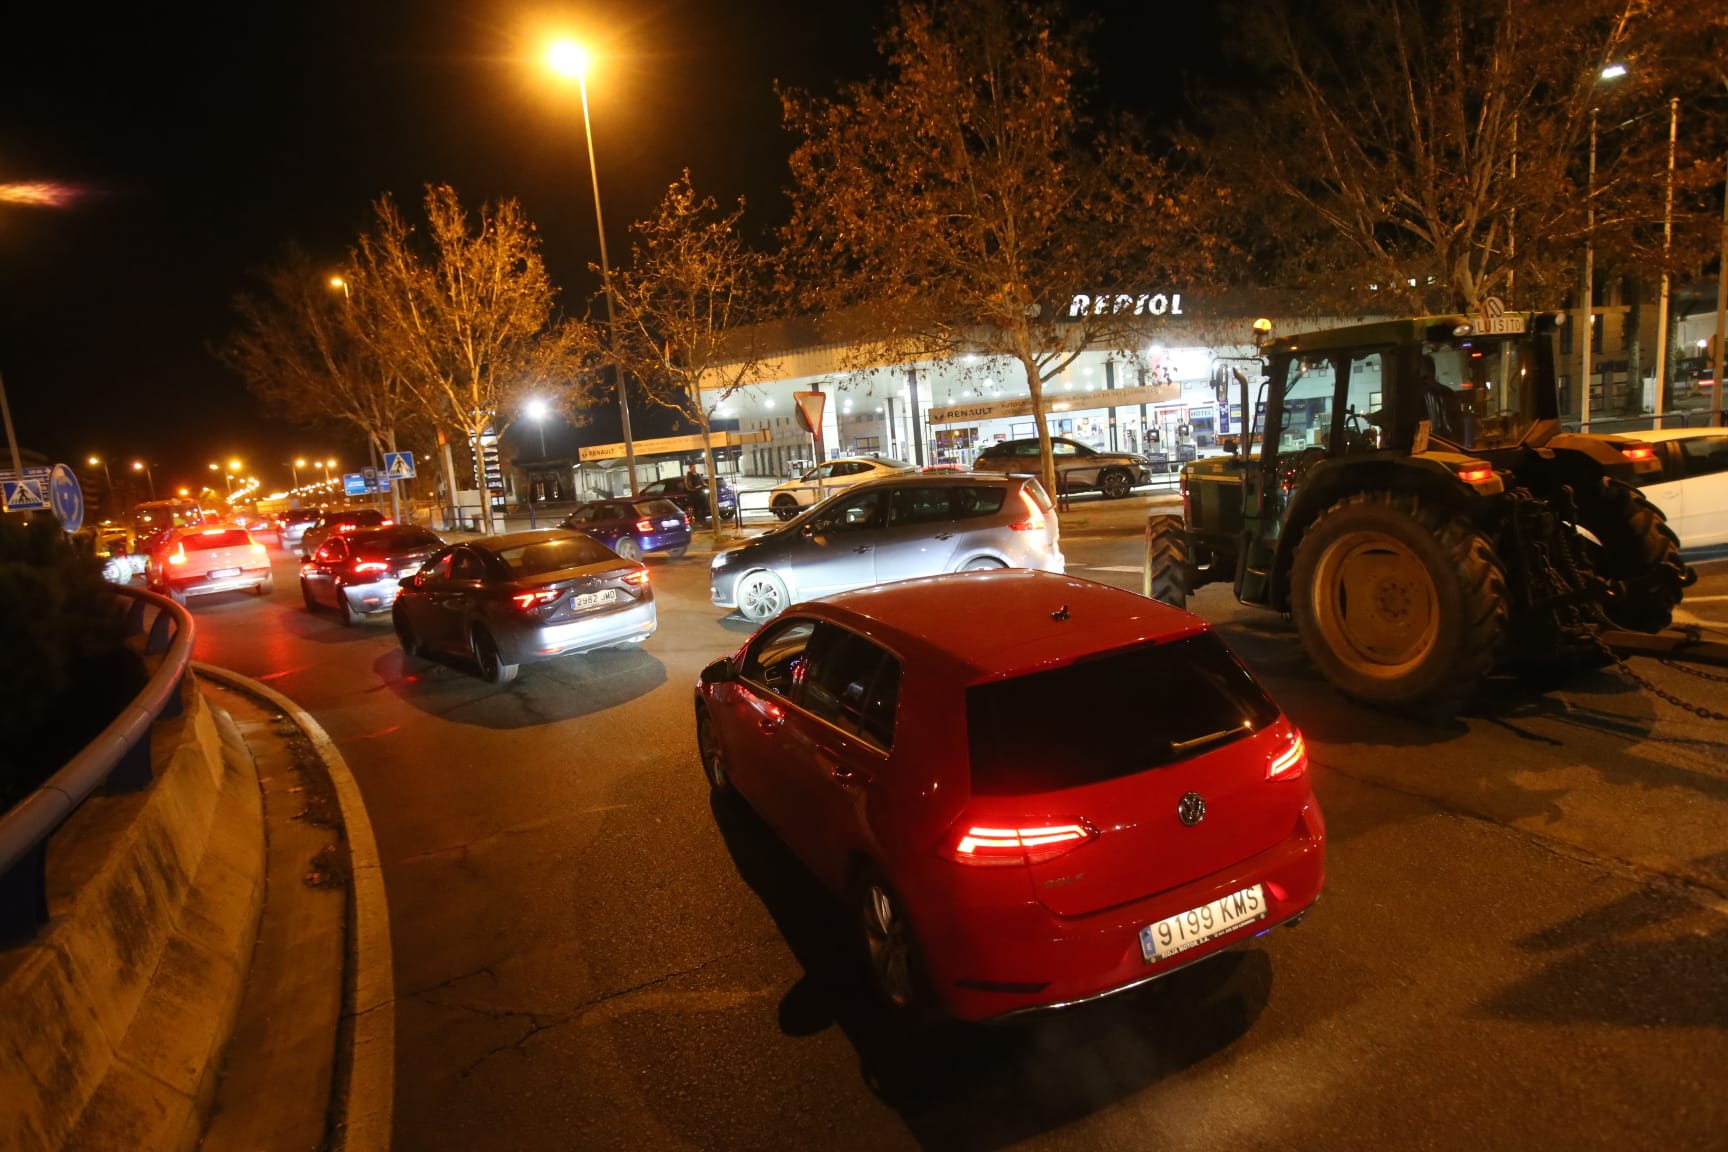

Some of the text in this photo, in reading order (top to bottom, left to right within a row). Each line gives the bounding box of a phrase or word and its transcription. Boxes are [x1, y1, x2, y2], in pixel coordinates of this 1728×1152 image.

[1069, 293, 1183, 317] REPSOL
[1477, 319, 1521, 333] LUISITO
[947, 407, 993, 419] RENAULT
[588, 448, 615, 457] RENAULT
[1158, 905, 1214, 946] 9199
[1219, 887, 1259, 923] KMS
